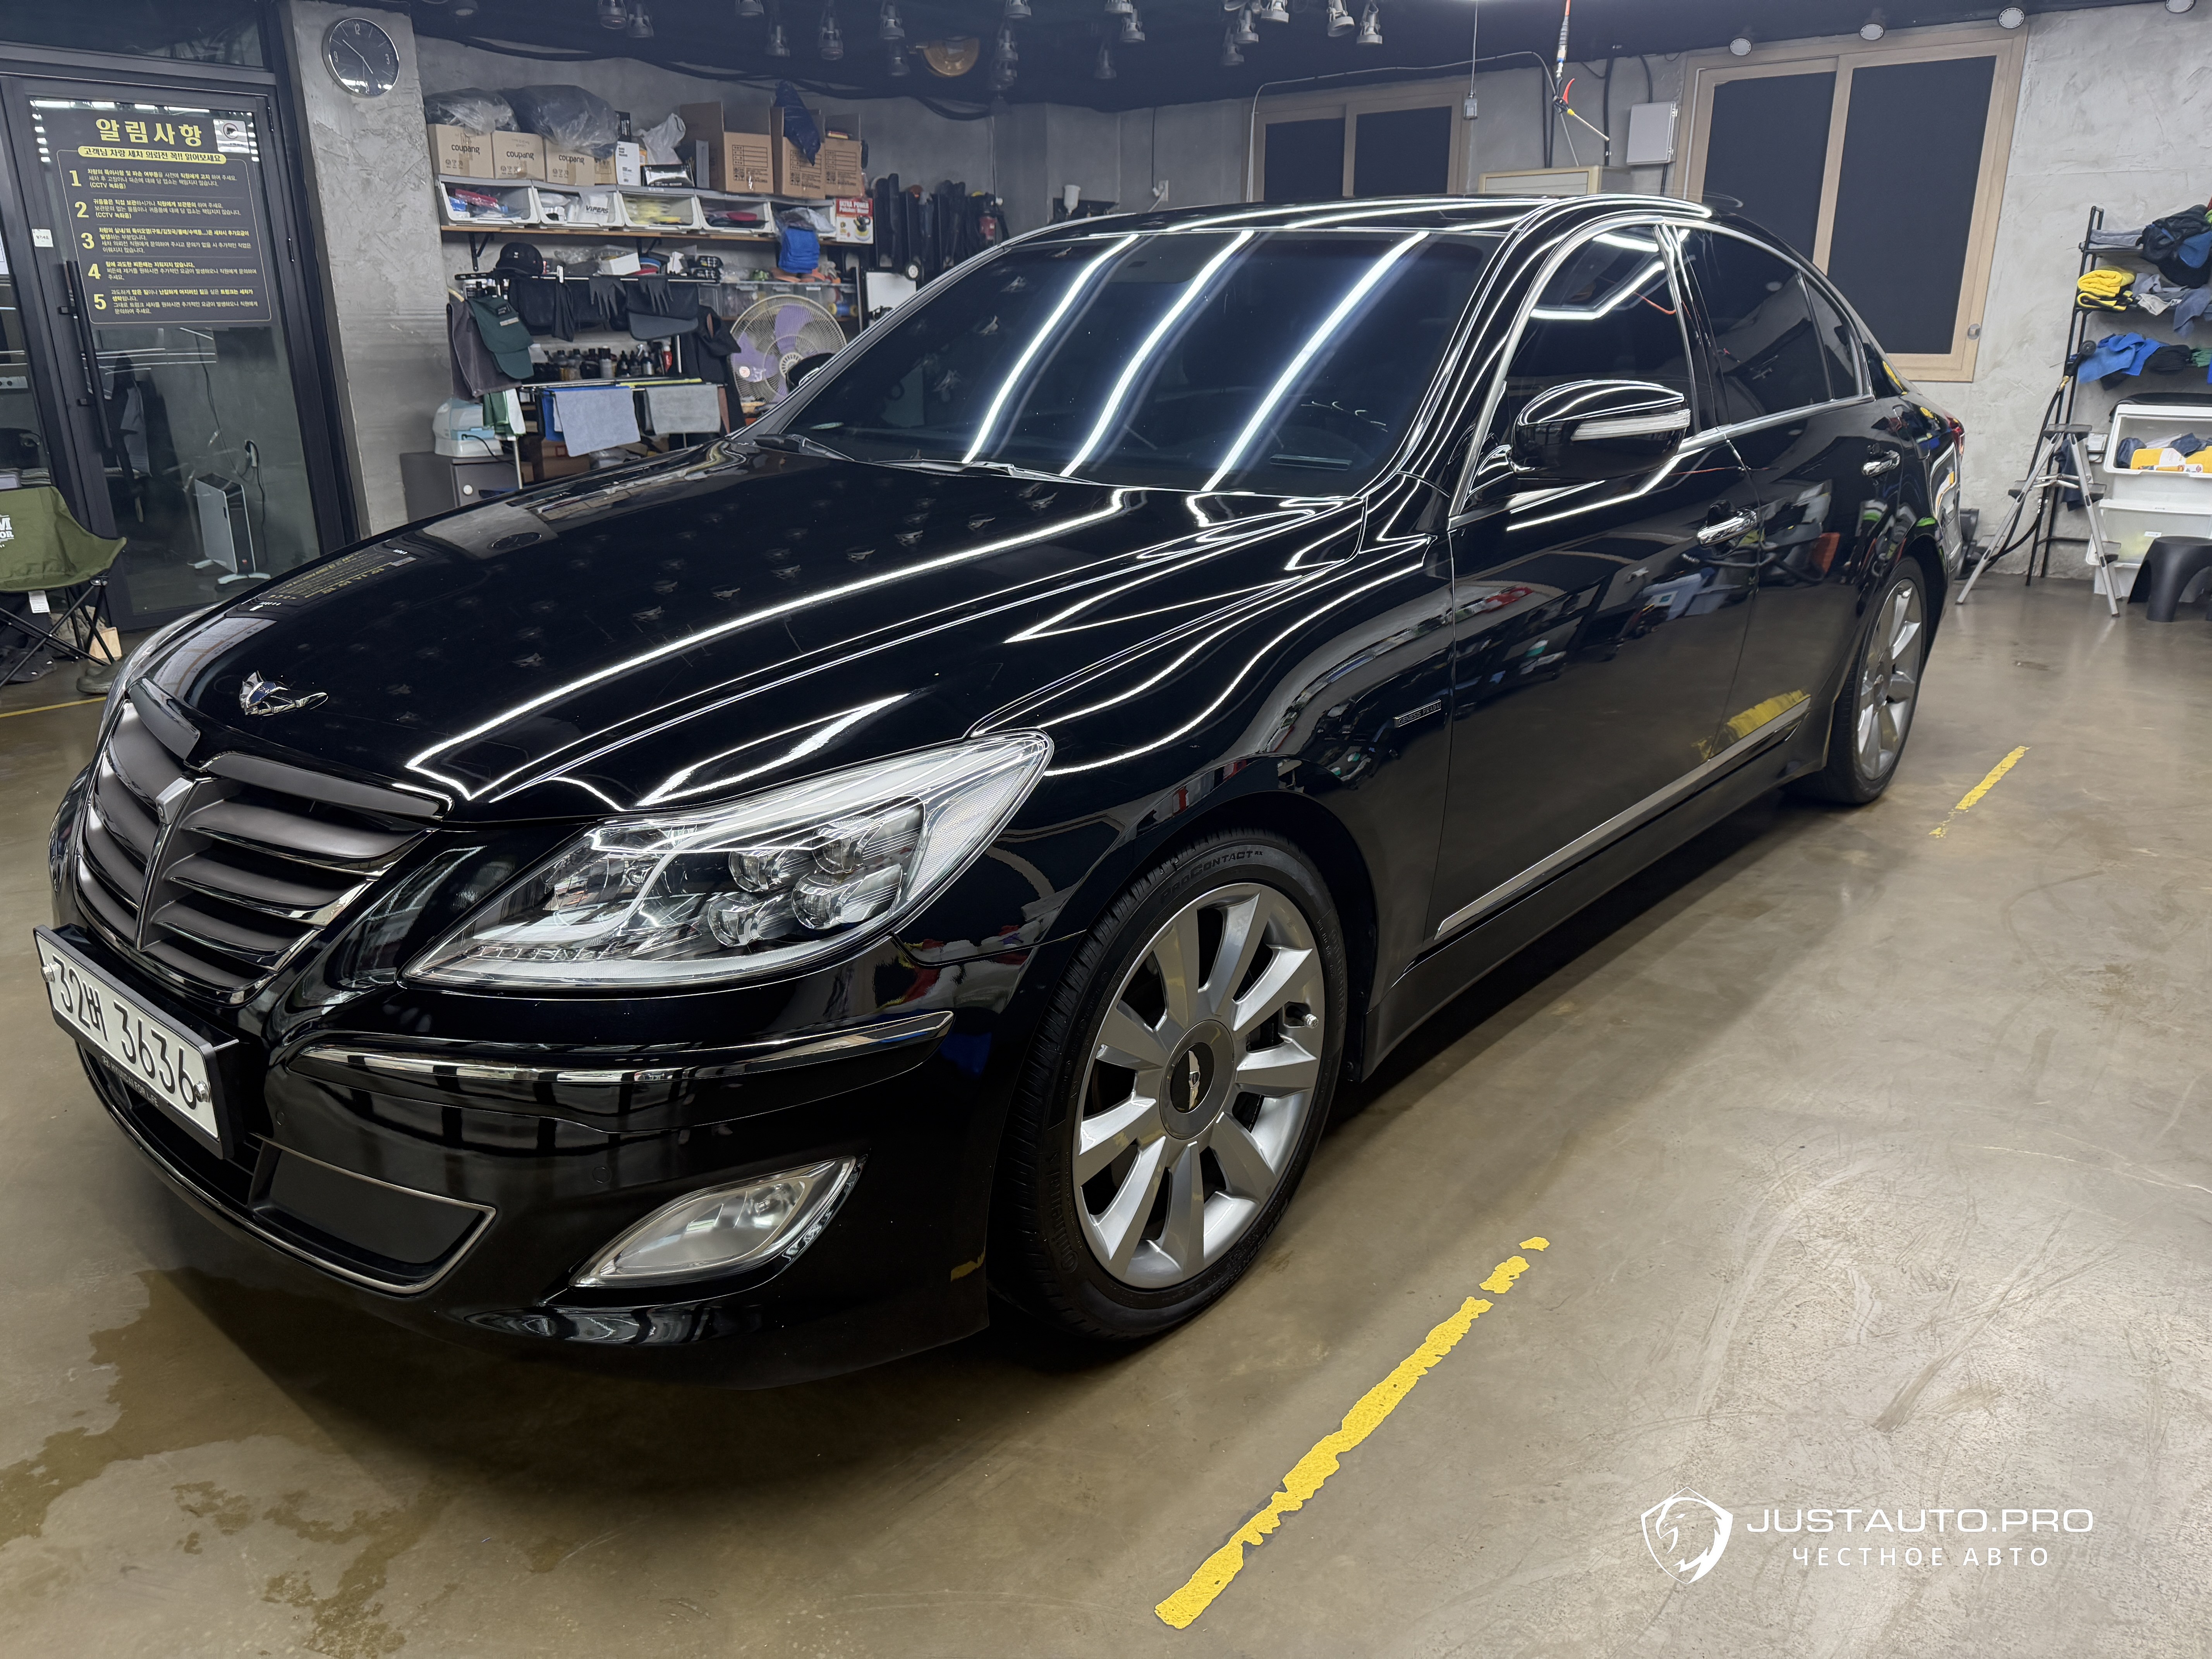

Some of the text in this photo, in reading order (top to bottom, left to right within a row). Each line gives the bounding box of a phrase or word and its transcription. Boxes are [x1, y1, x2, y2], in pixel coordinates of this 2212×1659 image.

[354, 24, 361, 35] 12
[385, 53, 390, 64] 3
[96, 119, 202, 147] 알림사항
[84, 148, 108, 156] 고객님
[185, 153, 221, 161] 읽어보세요
[452, 144, 480, 155] coupang
[507, 151, 534, 160] coupang
[559, 155, 585, 165] coupang
[69, 170, 82, 187] 1
[75, 201, 89, 218] 2
[586, 205, 609, 213] VIPERS
[81, 233, 94, 249] 3
[88, 263, 101, 279] 4
[94, 294, 106, 310] 5
[1399, 703, 1440, 725] GENESIS PRADA
[52, 953, 197, 1111] 32버 3636
